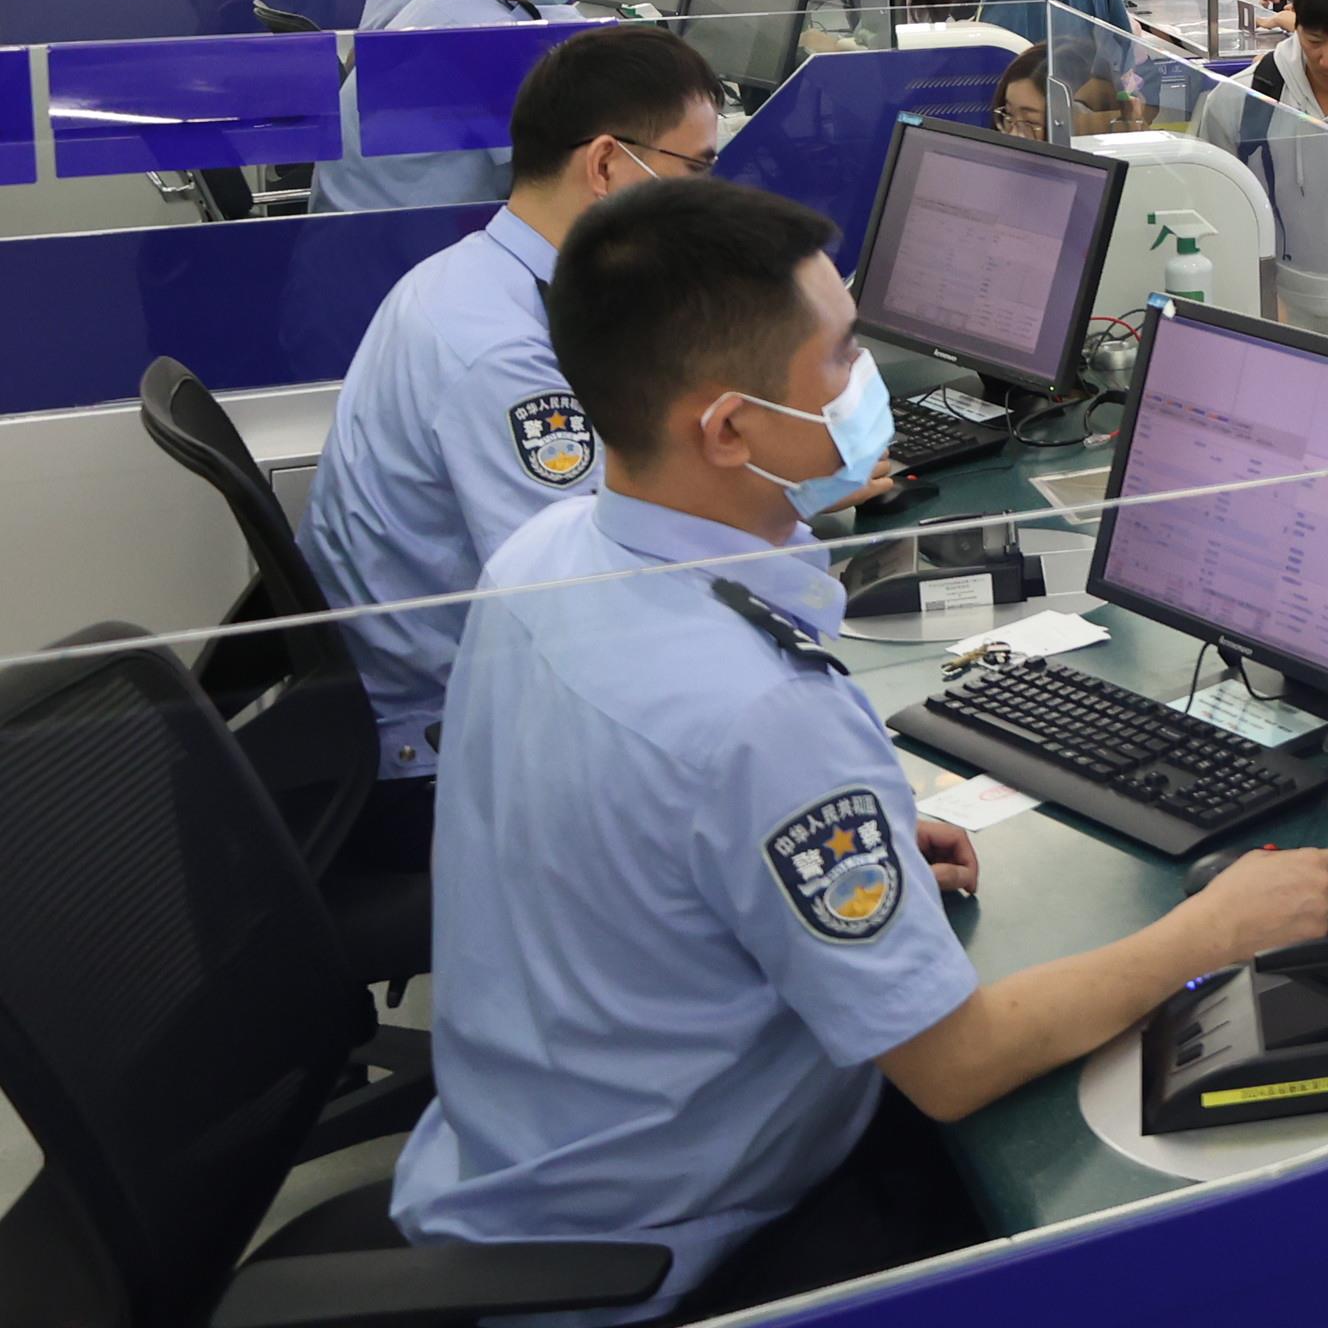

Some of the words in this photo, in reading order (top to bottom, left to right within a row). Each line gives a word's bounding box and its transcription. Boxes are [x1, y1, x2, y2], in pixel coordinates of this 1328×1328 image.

[774, 794, 877, 857] 中华人民共和国
